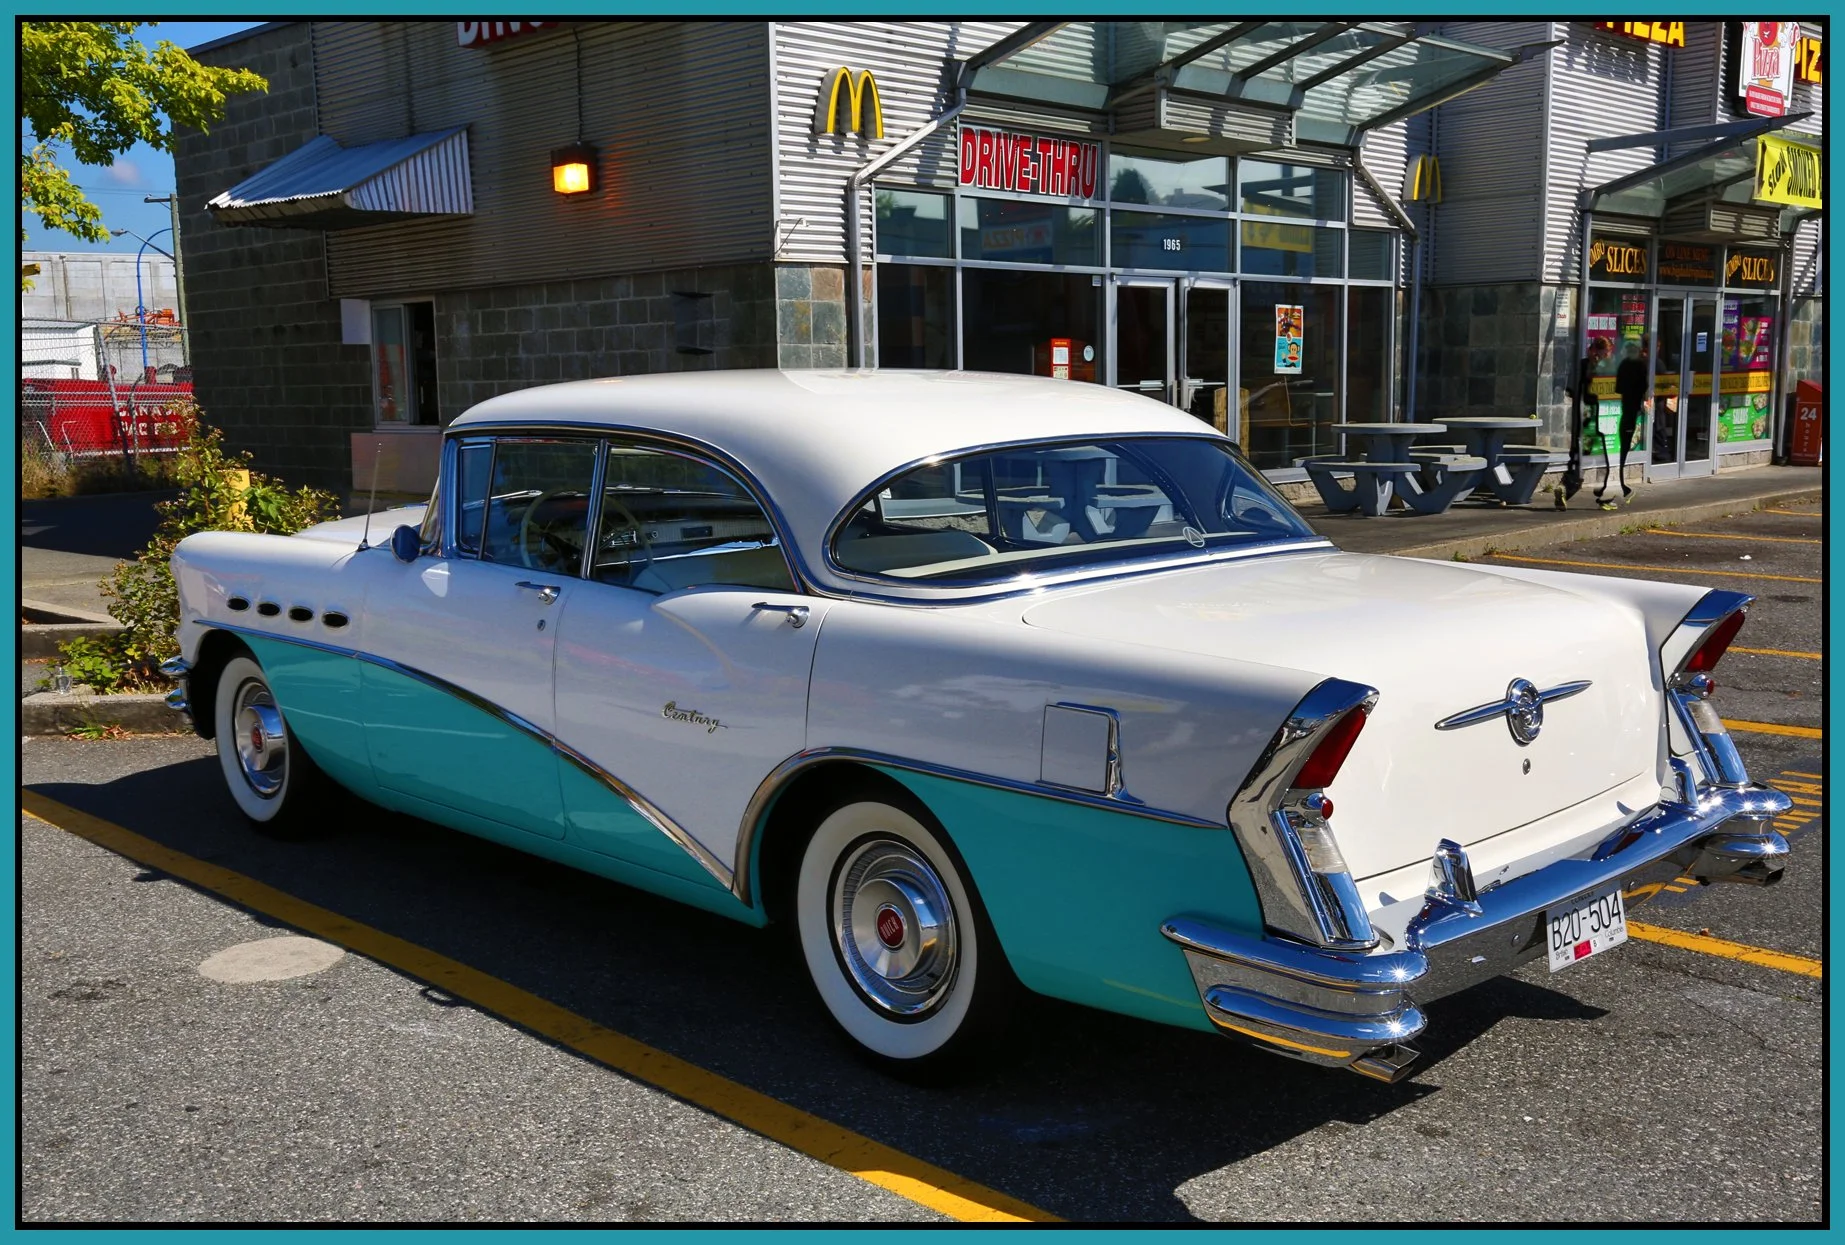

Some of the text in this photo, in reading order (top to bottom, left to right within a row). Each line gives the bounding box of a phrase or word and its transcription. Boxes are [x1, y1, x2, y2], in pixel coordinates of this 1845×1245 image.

[1752, 36, 1781, 80] Pizza
[959, 127, 1098, 200] DRIVE-THRU
[1163, 238, 1181, 251] 1965
[1606, 246, 1647, 274] SLICES
[1742, 256, 1775, 282] SLICES
[1800, 406, 1817, 421] 24
[662, 701, 729, 734] Century
[1551, 890, 1622, 952] B20-504
